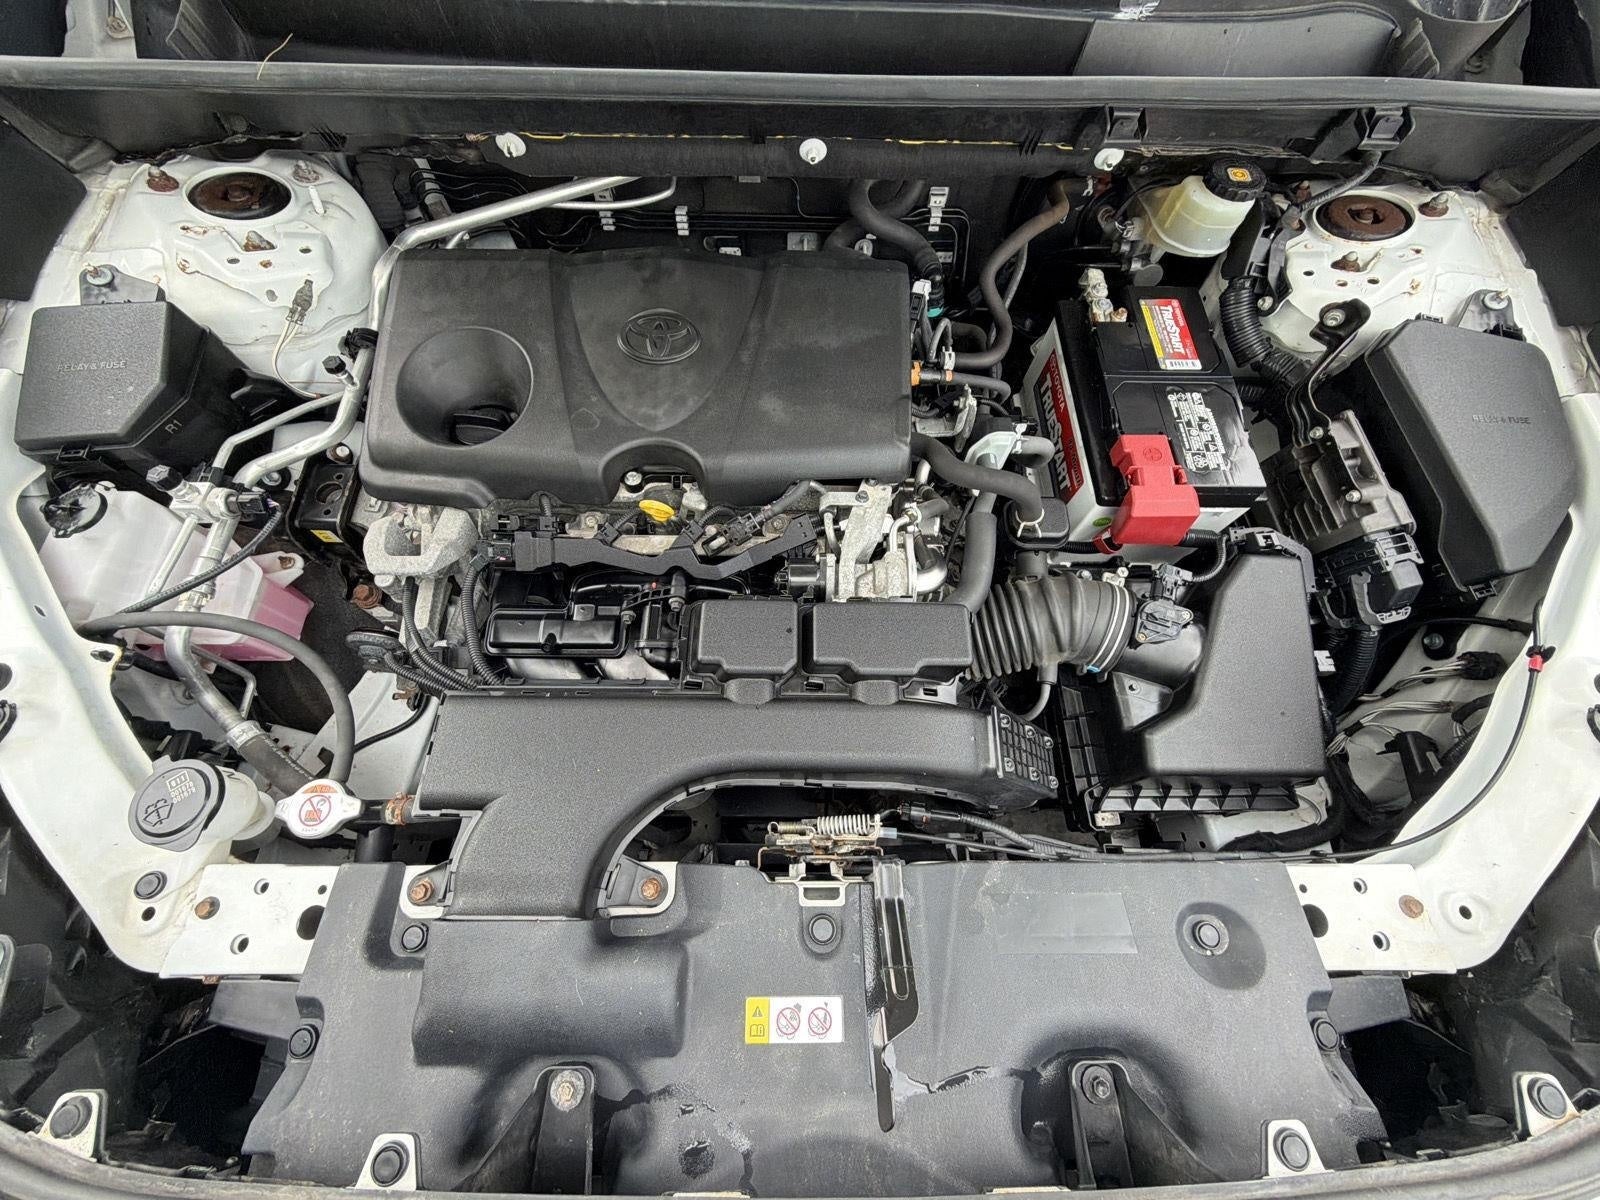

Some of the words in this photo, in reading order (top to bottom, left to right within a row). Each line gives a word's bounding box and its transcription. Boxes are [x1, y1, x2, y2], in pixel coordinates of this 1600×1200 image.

[56, 361, 89, 372] RELAY
[100, 360, 127, 369] FUSE
[1053, 368, 1065, 413] TOYOTA
[165, 419, 183, 434] R1
[1508, 415, 1532, 425] FUSE
